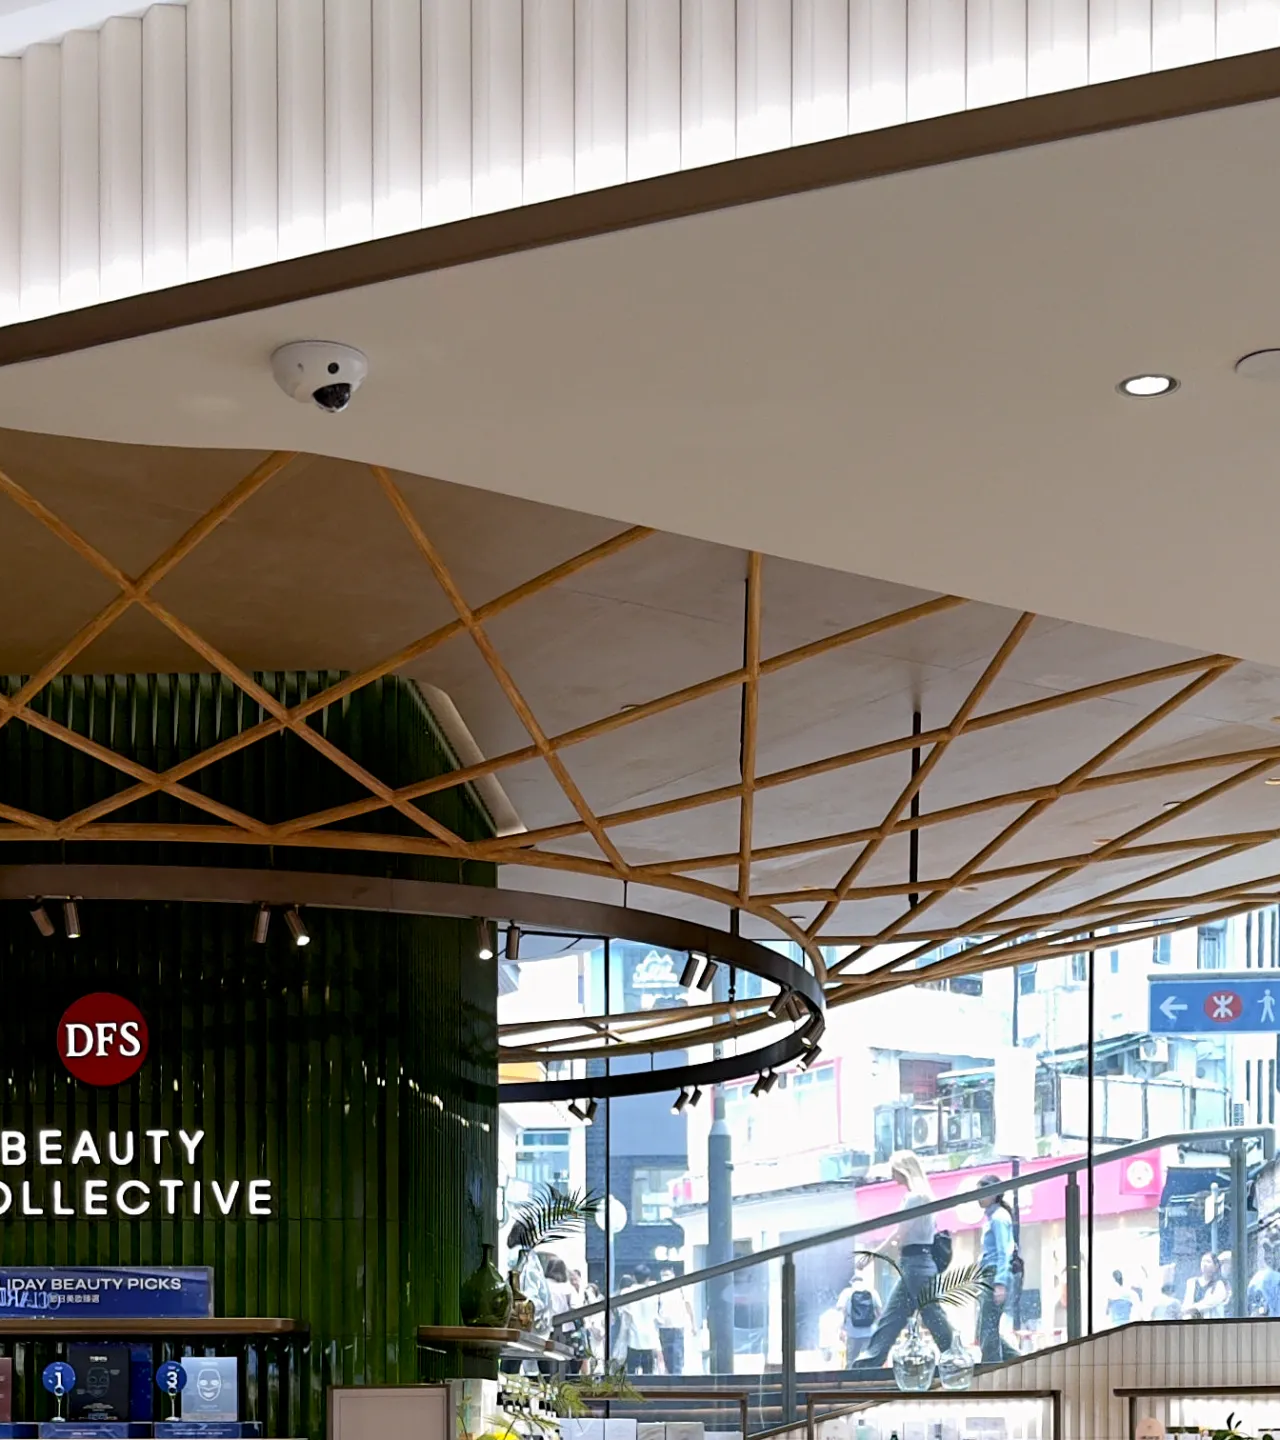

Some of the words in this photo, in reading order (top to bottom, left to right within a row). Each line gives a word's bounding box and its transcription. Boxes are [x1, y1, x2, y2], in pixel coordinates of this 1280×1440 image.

[65, 1021, 142, 1058] DFS
[1, 1129, 206, 1167] BEAUTY
[51, 1278, 123, 1290] BEAUTY
[127, 1278, 182, 1290] PICKS
[55, 1372, 62, 1386] 1
[167, 1371, 178, 1387] 3
